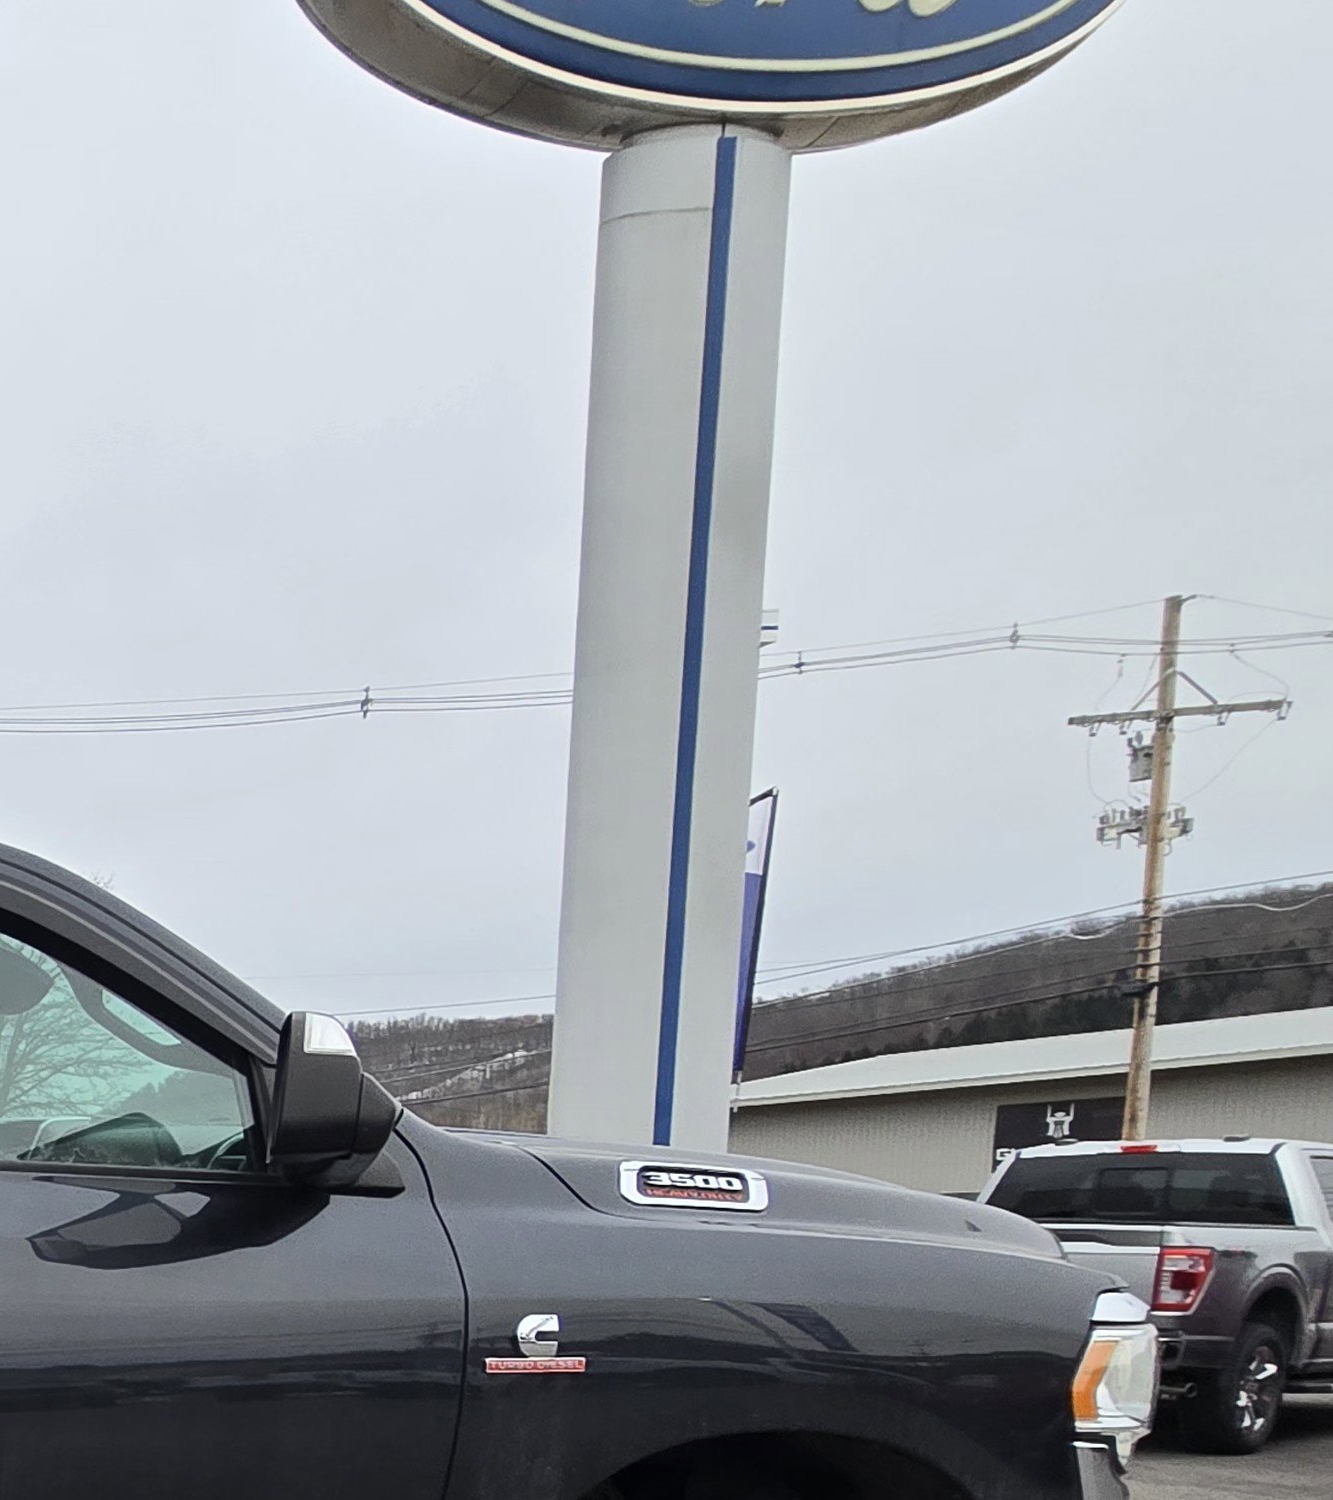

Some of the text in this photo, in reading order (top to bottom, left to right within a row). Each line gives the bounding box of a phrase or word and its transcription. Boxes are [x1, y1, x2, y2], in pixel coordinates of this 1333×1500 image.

[643, 1171, 743, 1191] 3500
[488, 1360, 584, 1371] TURBO DIESEL
